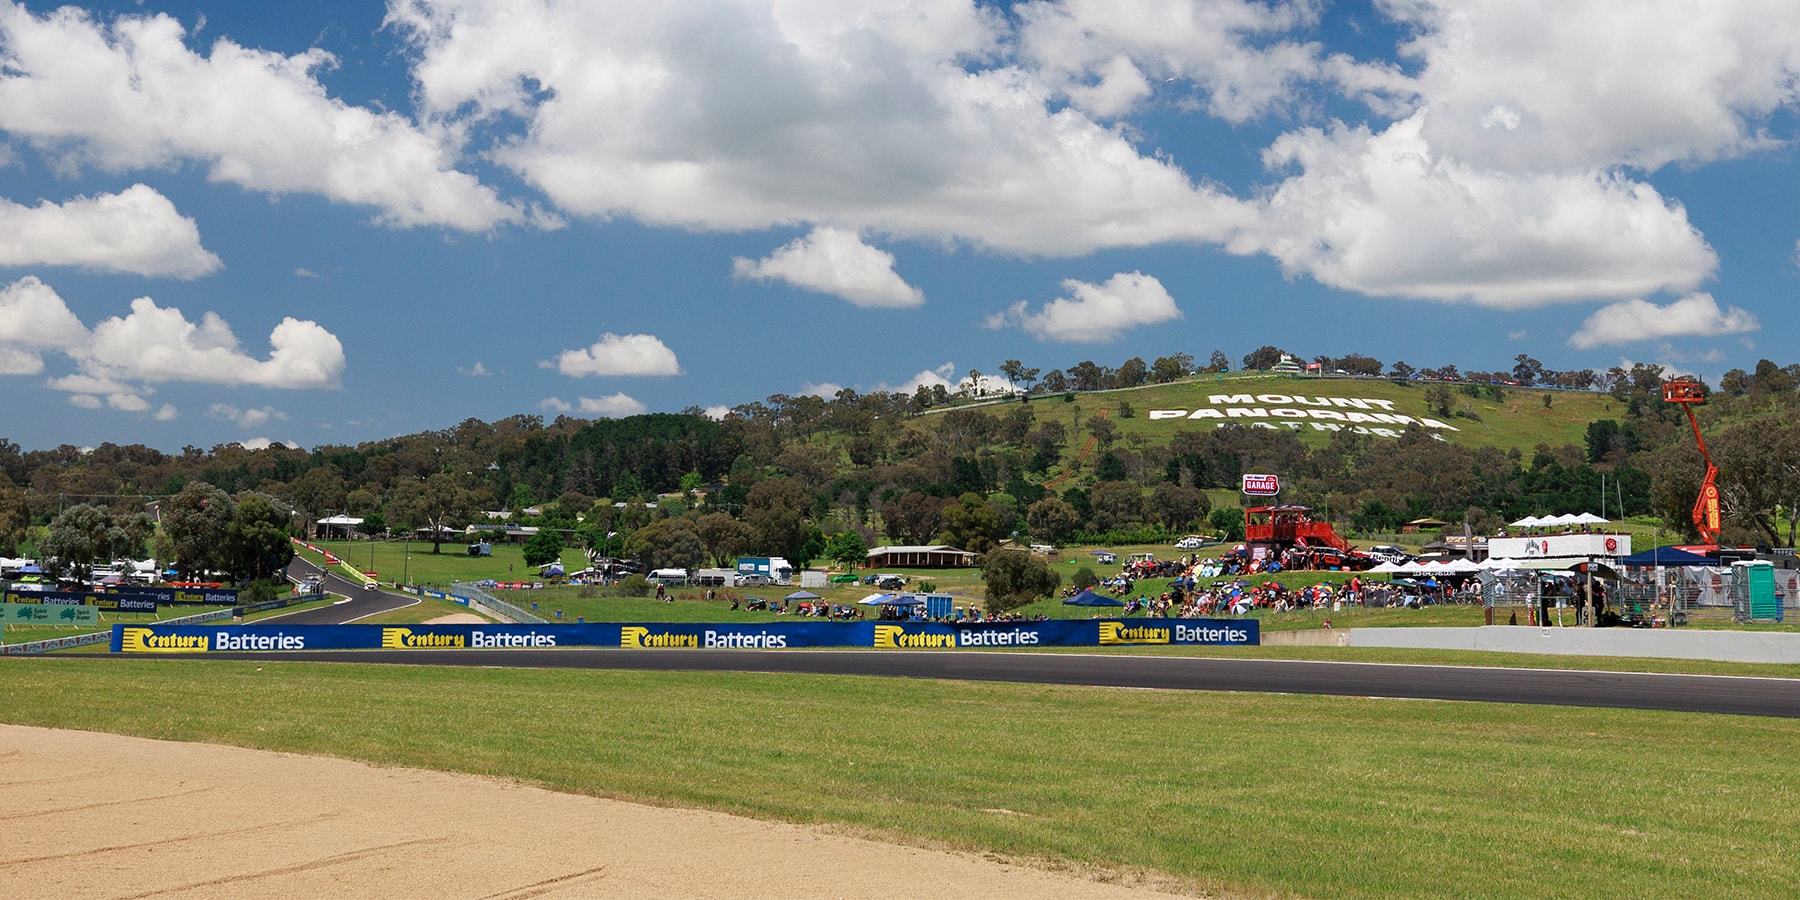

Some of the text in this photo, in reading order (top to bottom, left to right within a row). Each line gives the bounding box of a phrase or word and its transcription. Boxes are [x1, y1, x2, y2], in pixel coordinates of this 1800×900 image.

[1208, 394, 1395, 411] MOUNT
[1149, 407, 1461, 431] PANORAMA
[1246, 481, 1275, 490] GARAGE
[43, 596, 80, 606] Batteries
[85, 596, 155, 609] Century Batteries
[174, 591, 205, 602] Century
[205, 593, 236, 602] Batteries
[122, 628, 209, 652] Century
[216, 632, 305, 650] Batteries
[382, 628, 557, 649] Century Batteries
[621, 626, 787, 648] Century Batteries
[874, 625, 1039, 648] Century Batteries
[1099, 622, 1248, 645] Century Batteries
